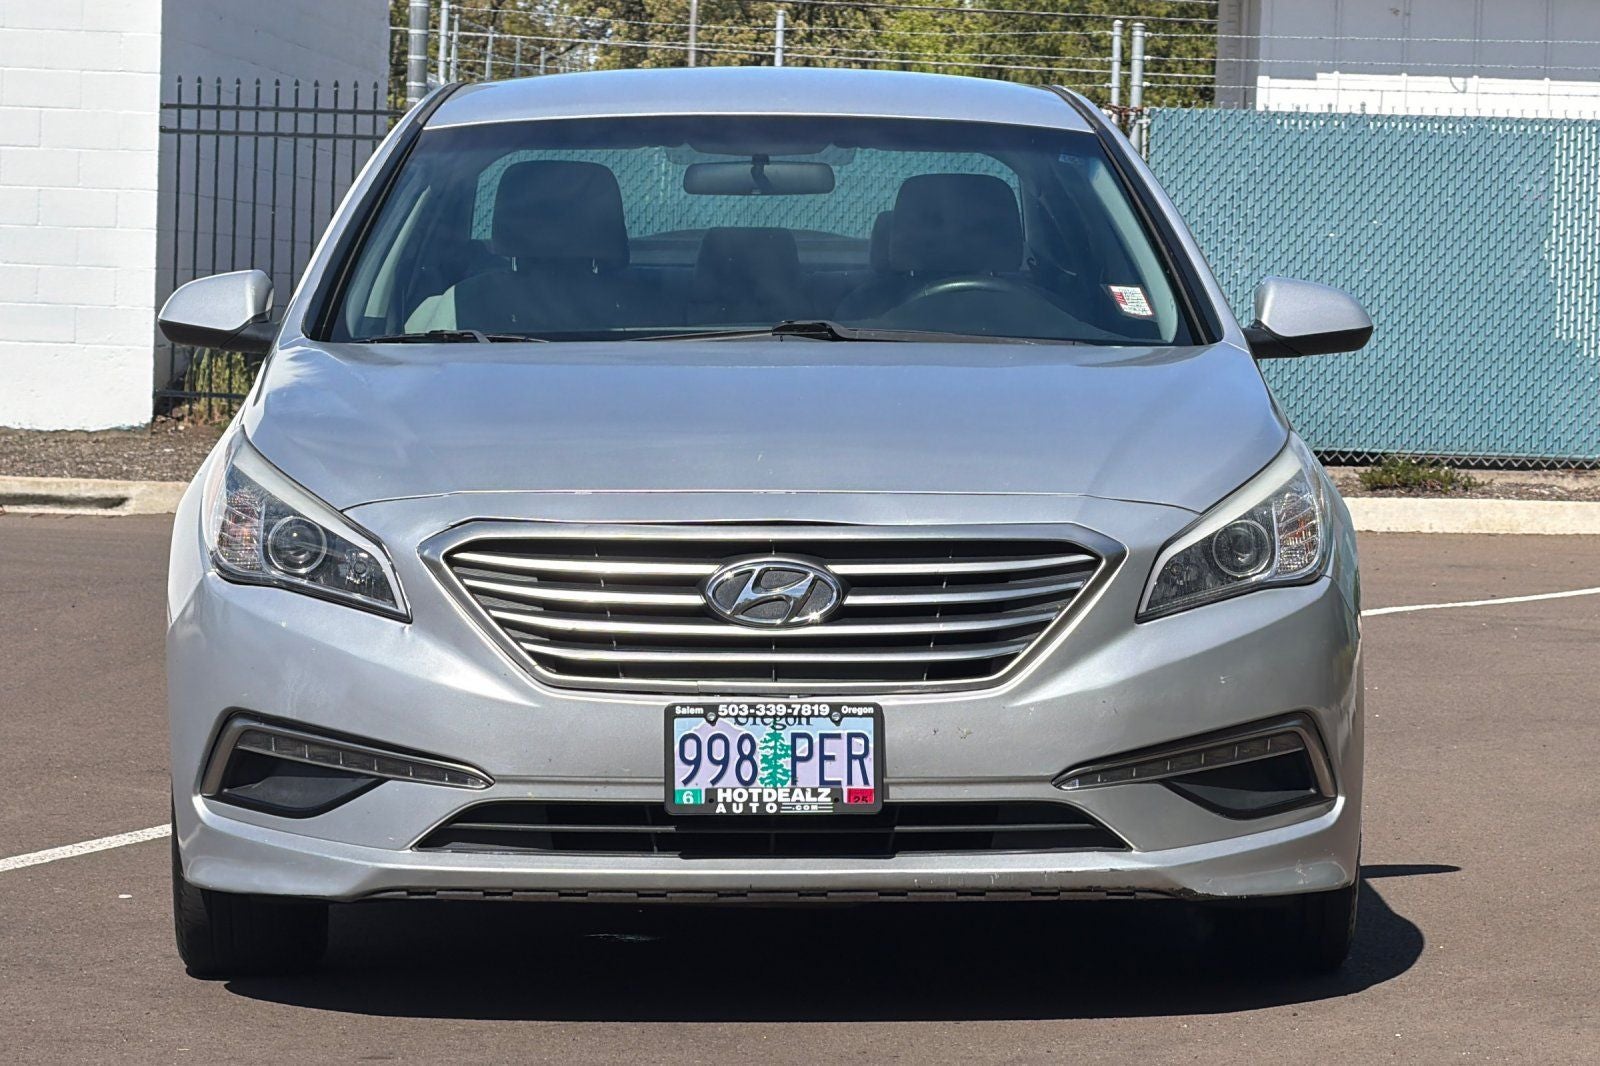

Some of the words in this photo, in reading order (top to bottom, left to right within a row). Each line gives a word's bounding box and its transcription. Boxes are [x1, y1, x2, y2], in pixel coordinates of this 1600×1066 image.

[675, 706, 704, 715] Salem
[718, 704, 830, 716] 503-339-7819
[841, 706, 874, 716] Oregon
[678, 732, 758, 786] 998
[790, 732, 870, 786] PER
[682, 791, 693, 804] 6
[717, 788, 832, 803] HOTDEALZ
[715, 803, 778, 813] AUTO
